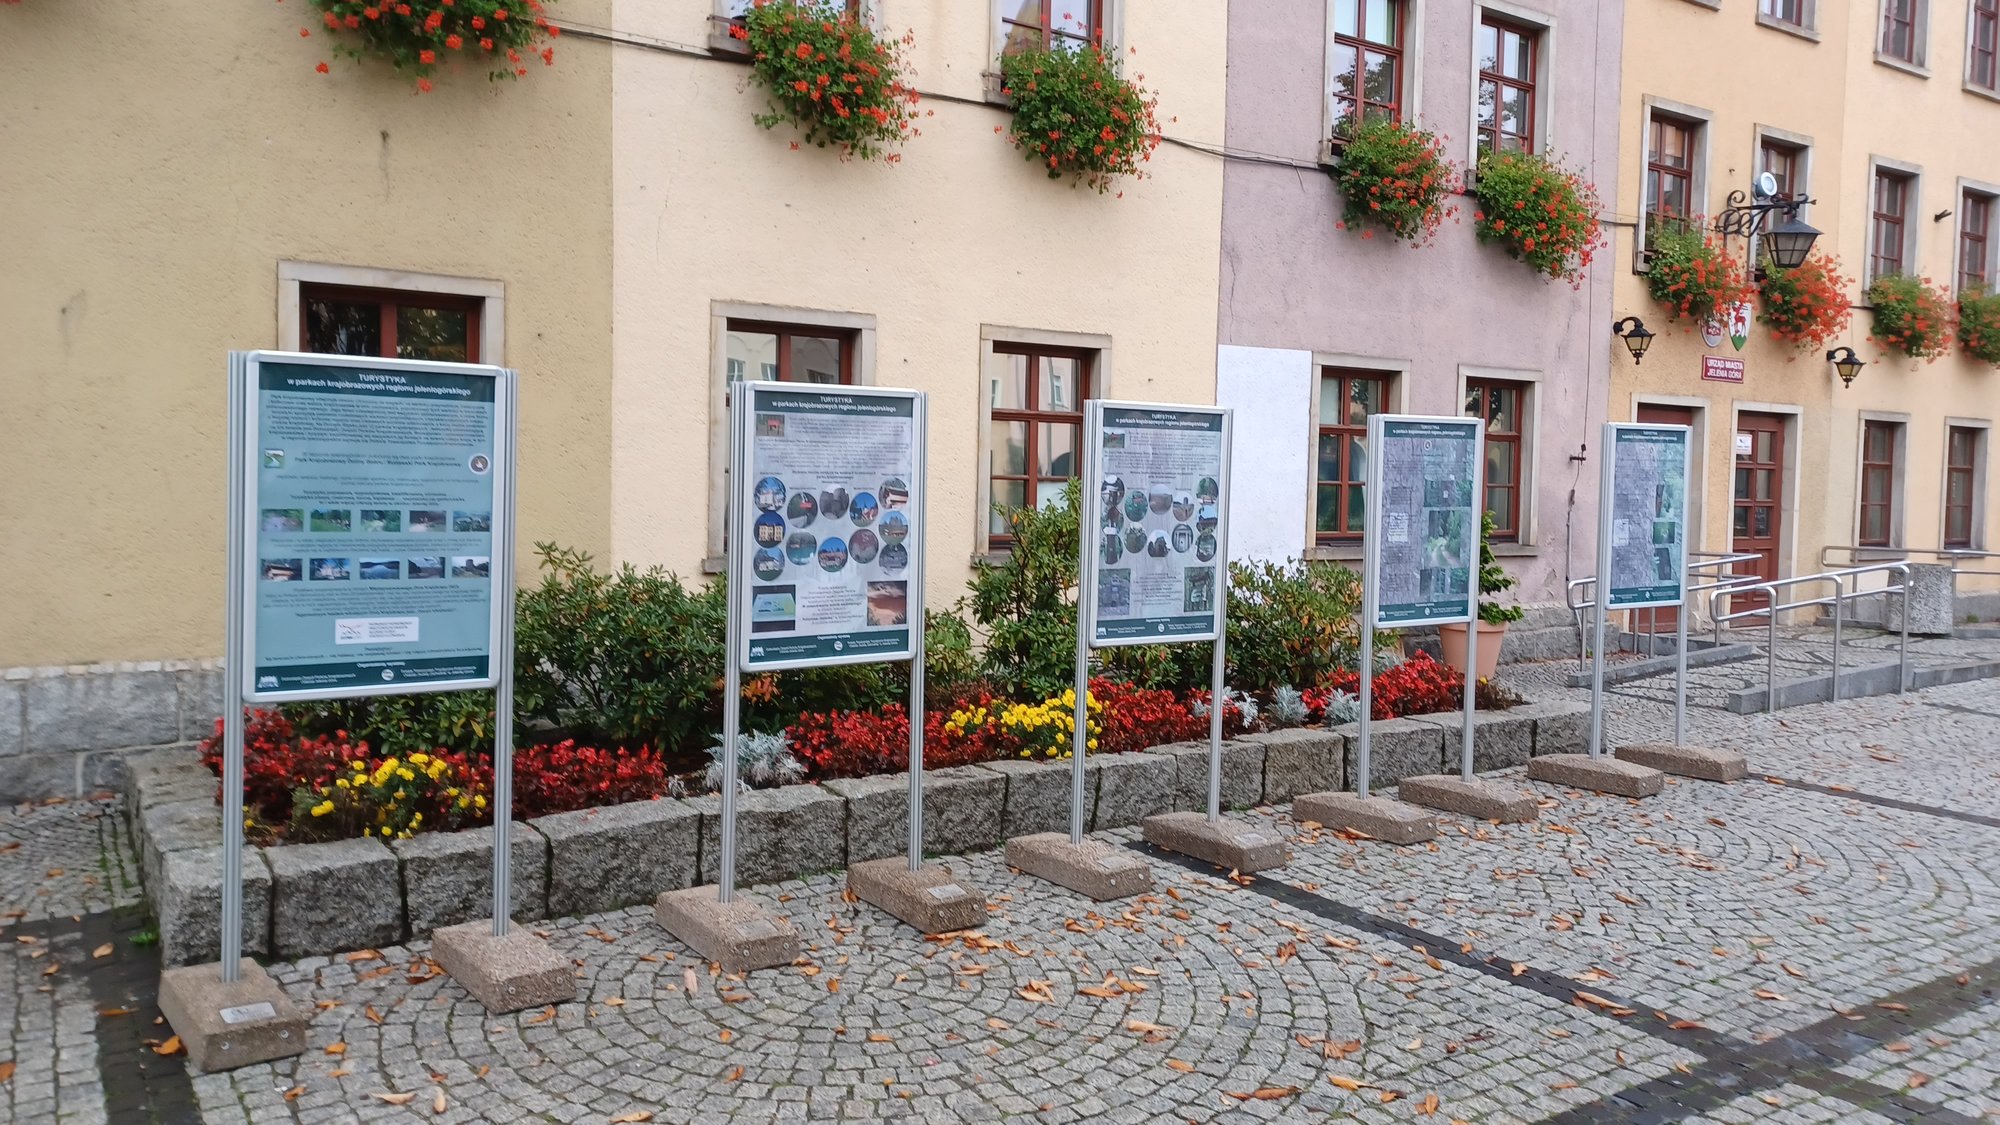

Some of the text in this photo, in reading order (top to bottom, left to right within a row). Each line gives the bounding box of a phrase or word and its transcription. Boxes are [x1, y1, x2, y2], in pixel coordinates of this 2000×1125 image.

[1707, 359, 1743, 370] URZĄD MIASTA
[358, 373, 406, 384] TURYSTYKA
[1707, 368, 1742, 379] JELENIA GÓRA
[295, 378, 326, 387] parkach
[327, 379, 385, 391] krajobrazowych
[386, 383, 413, 392] regionu
[414, 385, 471, 396] jeleniogórskiego
[820, 395, 852, 403] TURYSTYKA
